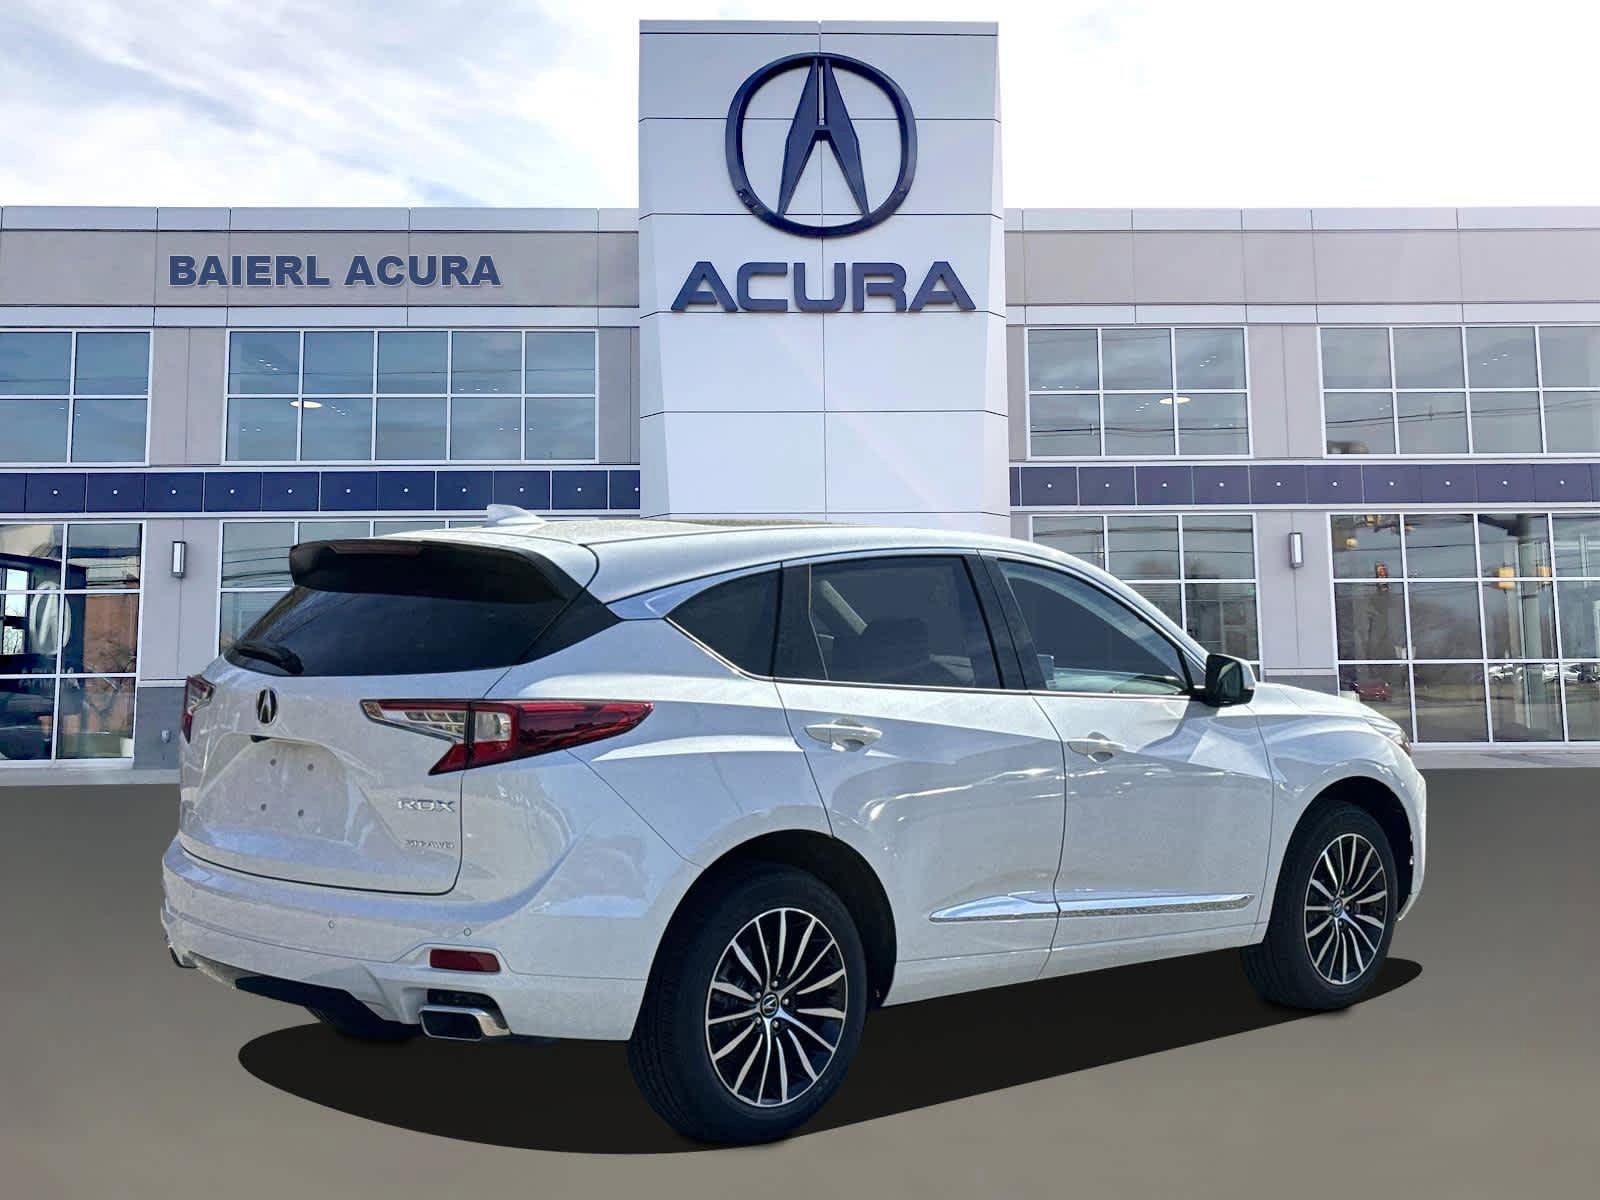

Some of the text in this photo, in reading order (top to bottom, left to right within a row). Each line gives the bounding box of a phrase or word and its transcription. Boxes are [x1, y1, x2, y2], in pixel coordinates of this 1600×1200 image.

[169, 255, 502, 286] BAIERL ACURA
[670, 261, 976, 313] ACURA
[397, 799, 456, 812] RDX
